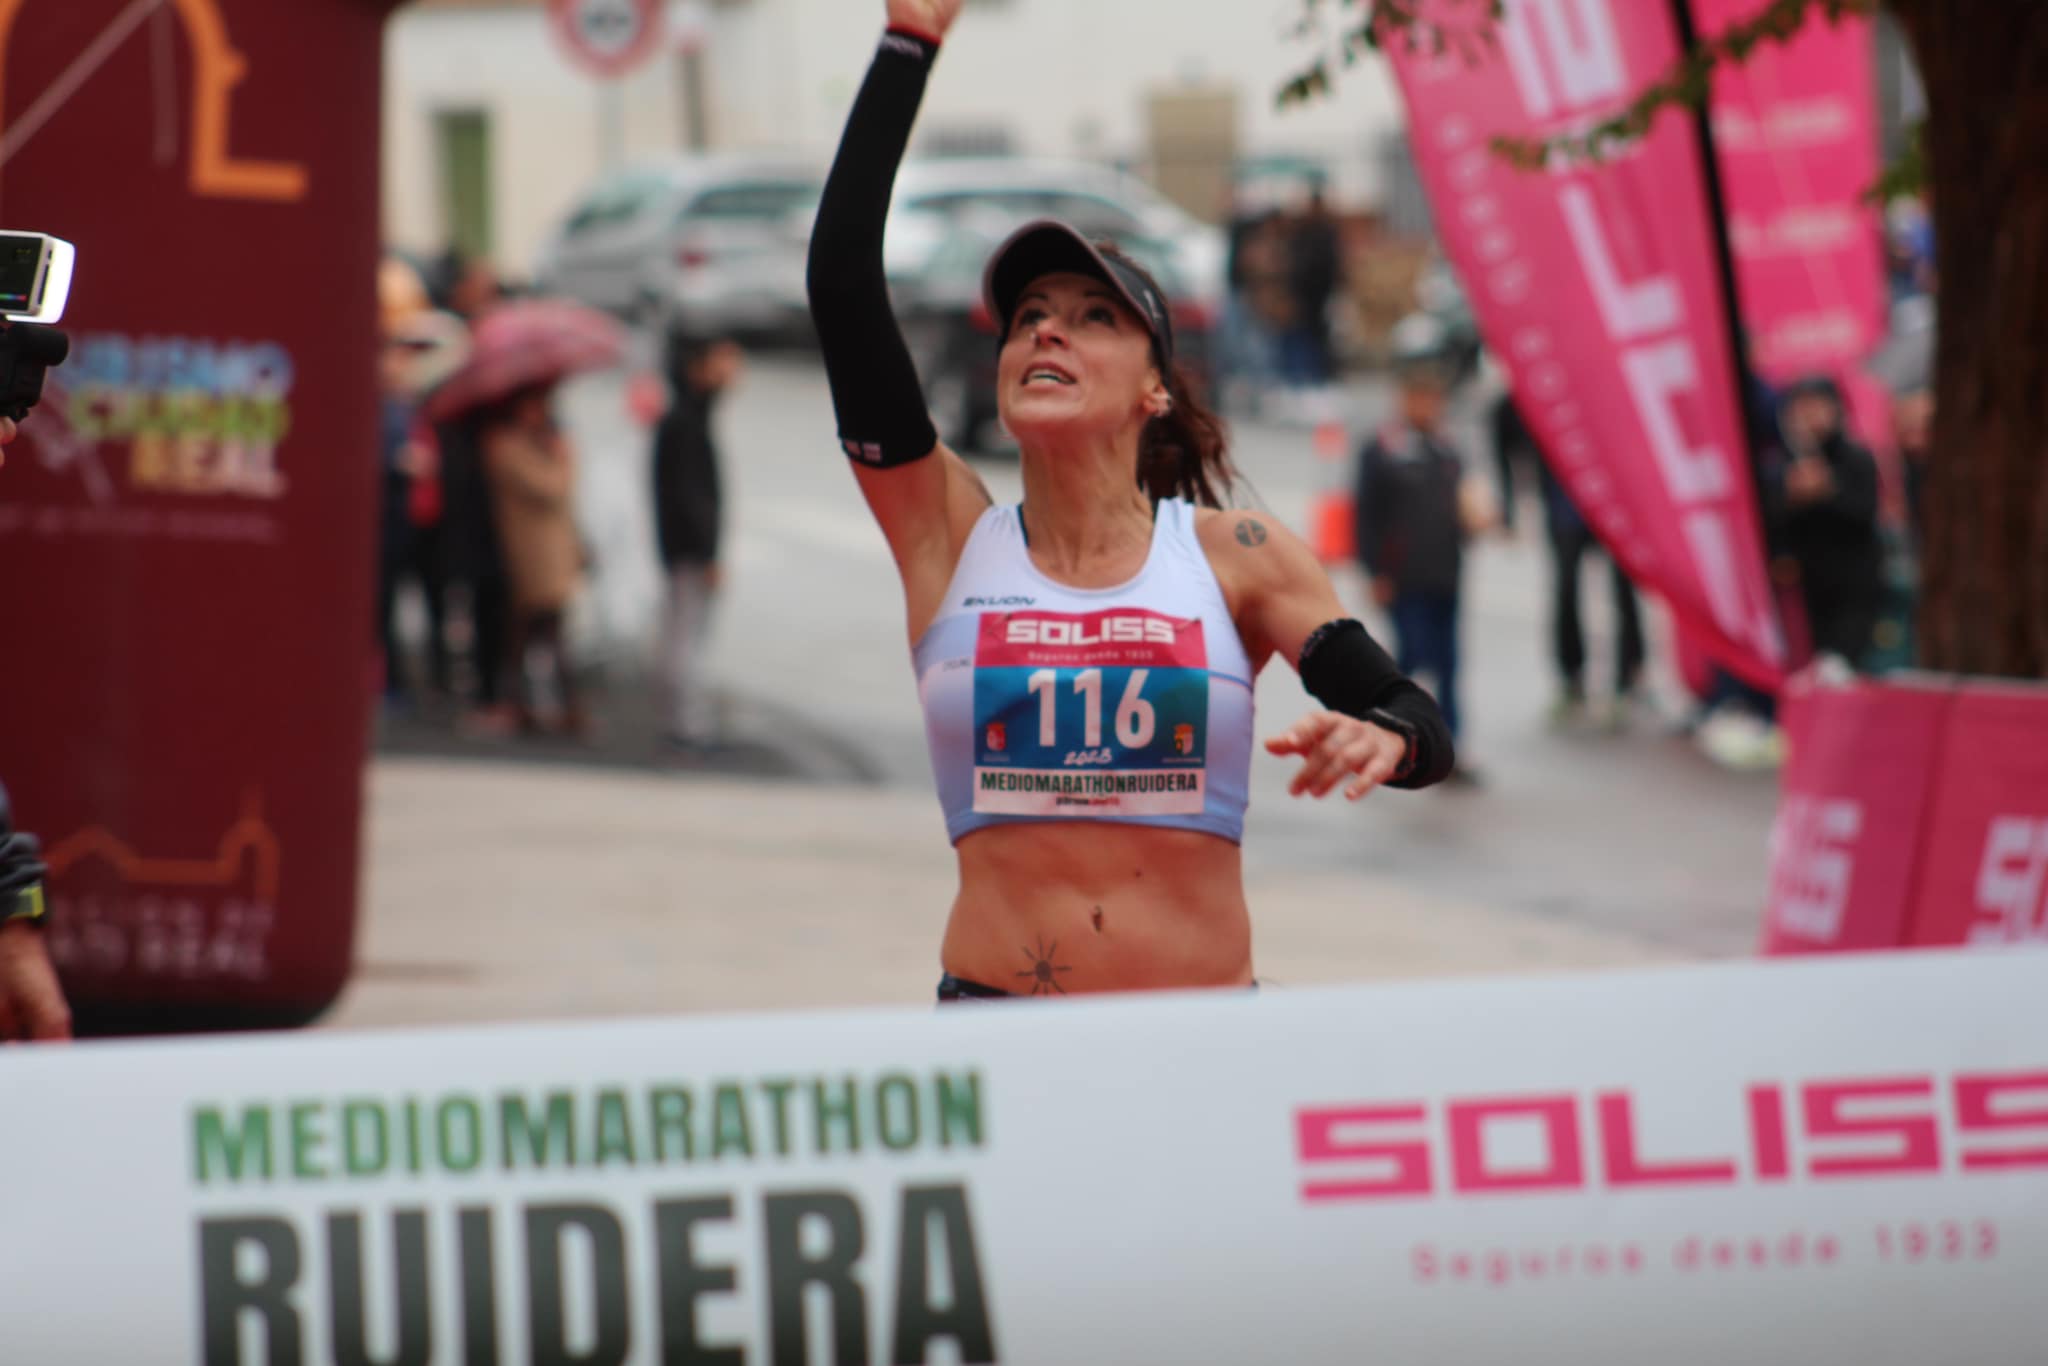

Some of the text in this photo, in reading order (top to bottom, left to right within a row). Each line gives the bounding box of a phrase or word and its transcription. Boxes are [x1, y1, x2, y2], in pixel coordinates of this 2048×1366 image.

[1005, 616, 1176, 646] SOLISS
[1027, 668, 1156, 749] 116
[980, 772, 1198, 794] MEDIOMARATHONRUIDERA
[192, 1069, 987, 1185] MEDIOMARATHON
[1294, 1067, 2048, 1203] SOLISS
[196, 1181, 999, 1366] RUIDERA
[1411, 1218, 1999, 1289] Seguros desde 1933
